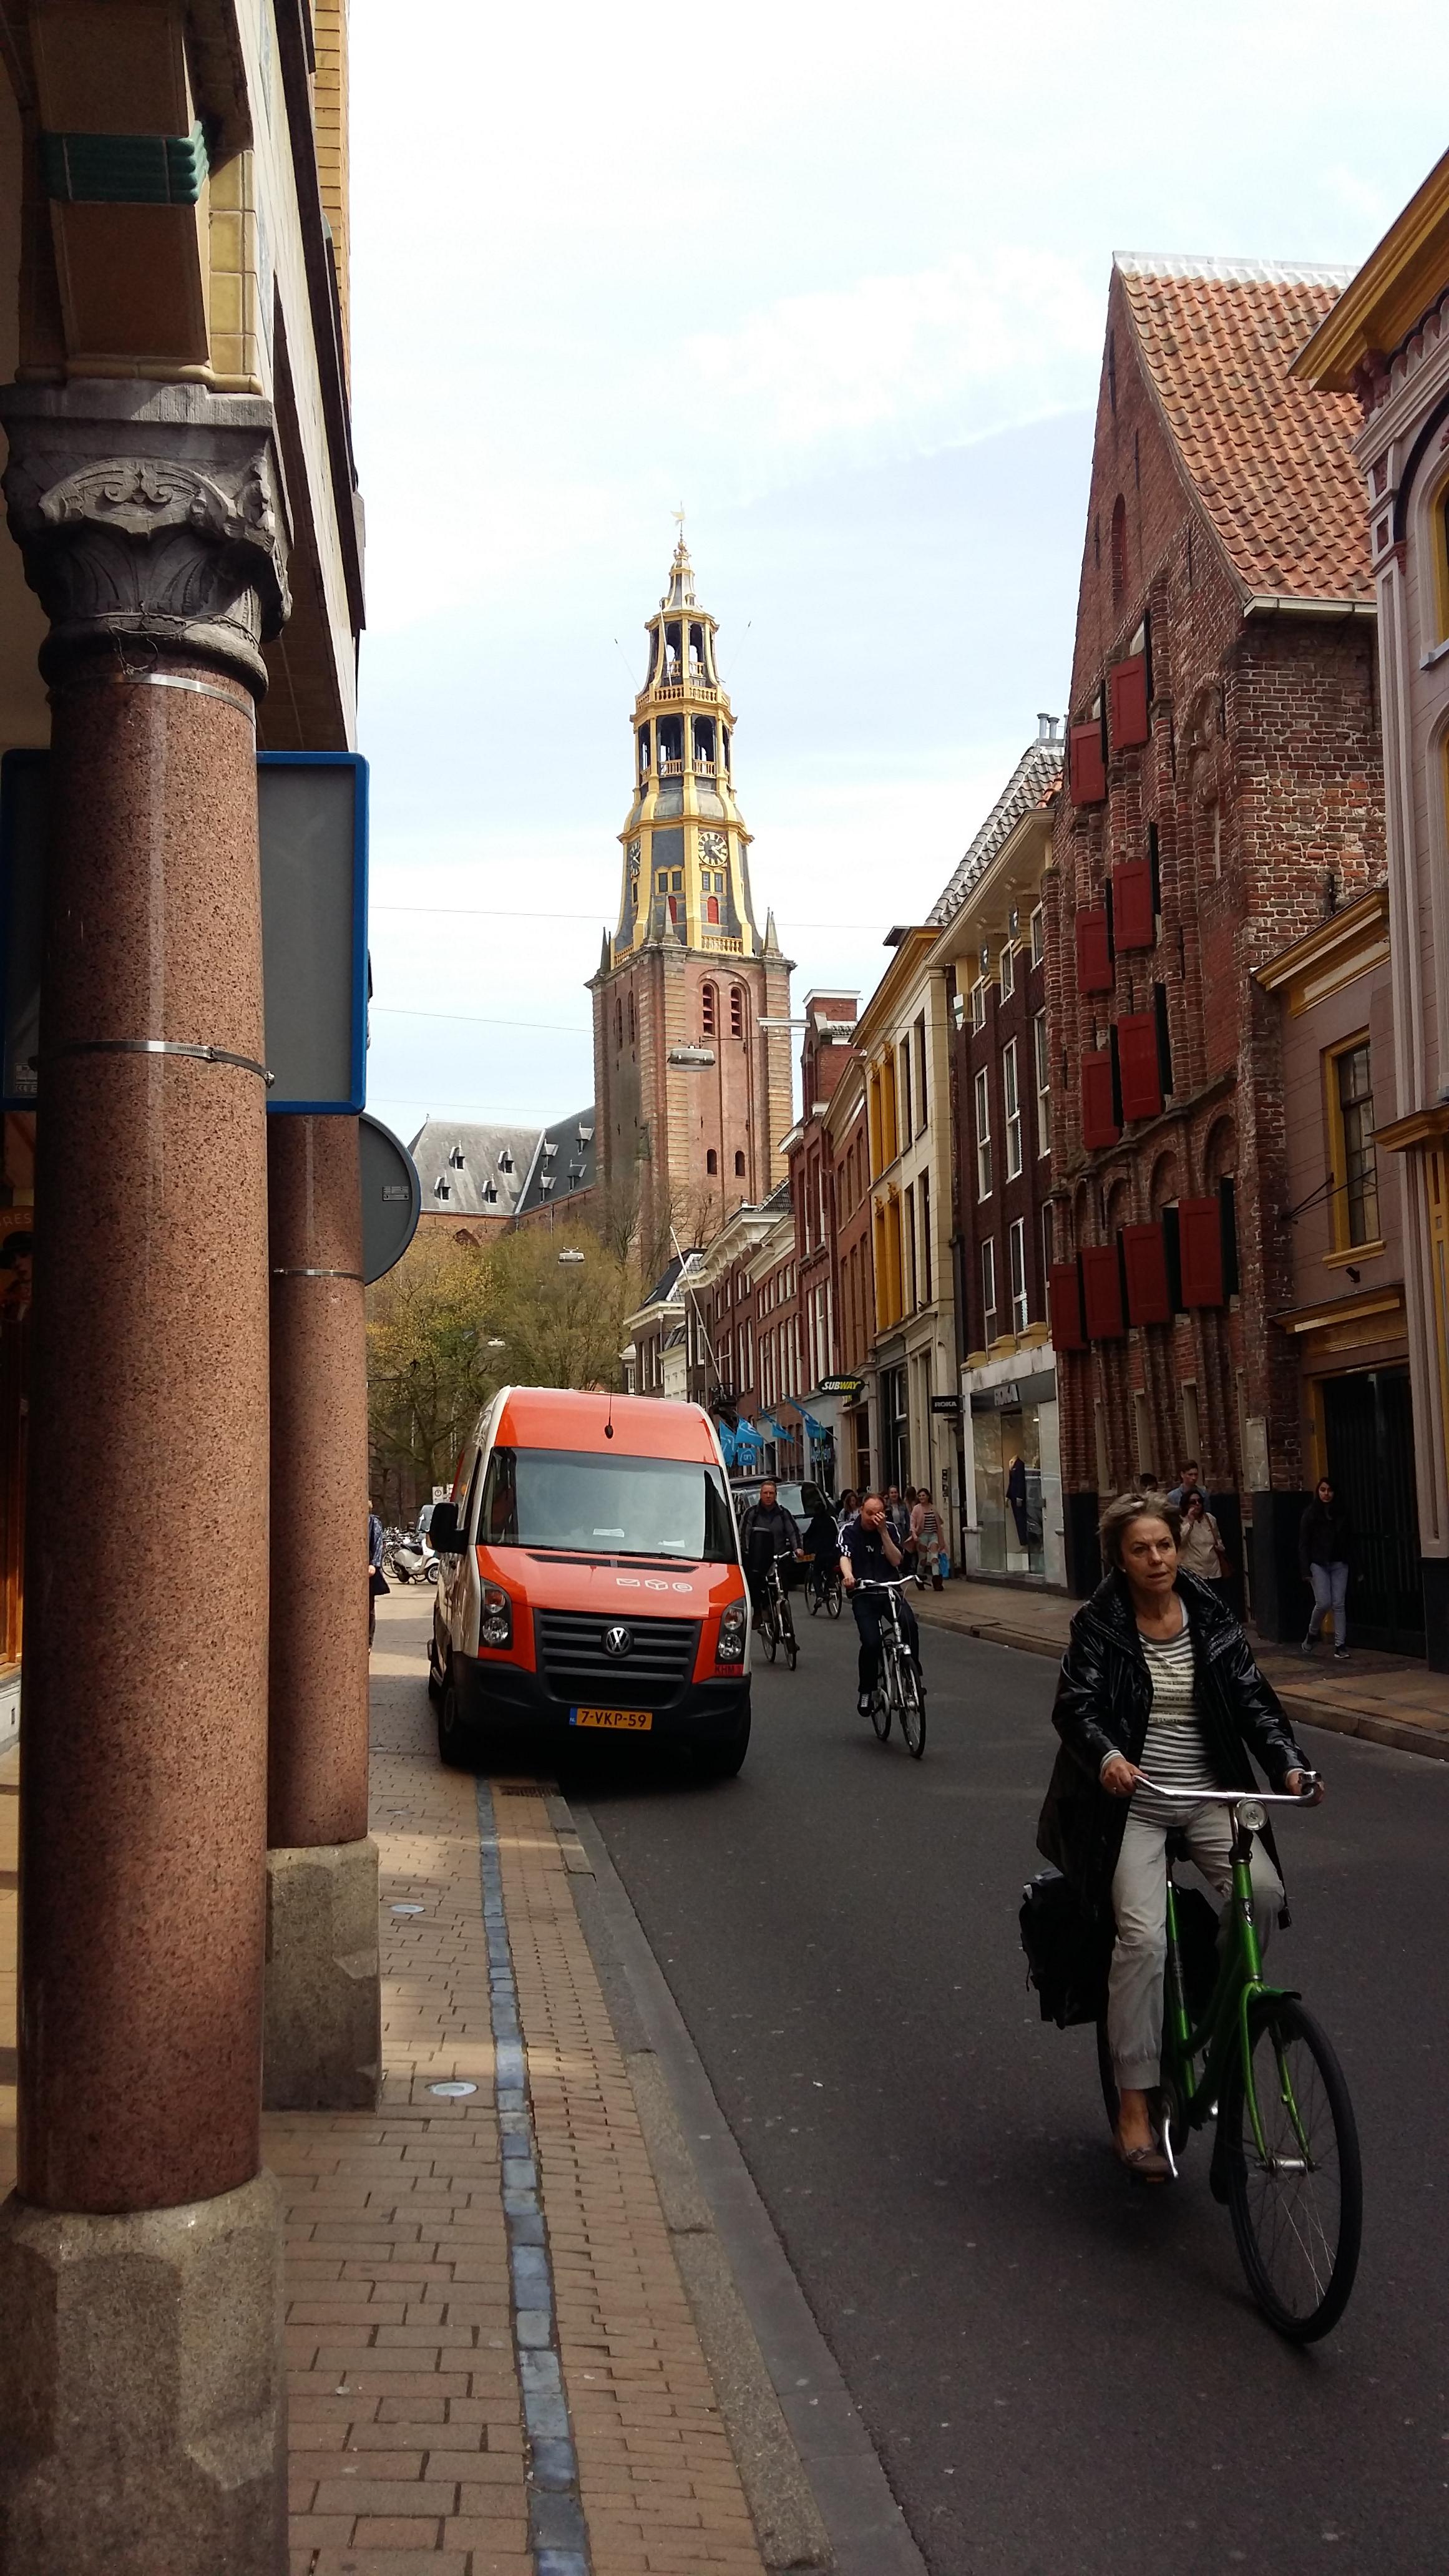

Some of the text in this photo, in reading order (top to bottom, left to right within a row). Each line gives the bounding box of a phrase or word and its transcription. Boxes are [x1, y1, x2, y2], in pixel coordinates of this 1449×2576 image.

[0, 1213, 31, 1227] RES
[821, 1381, 861, 1390] SUBWAY
[582, 1710, 646, 1727] 7-VKP-59
